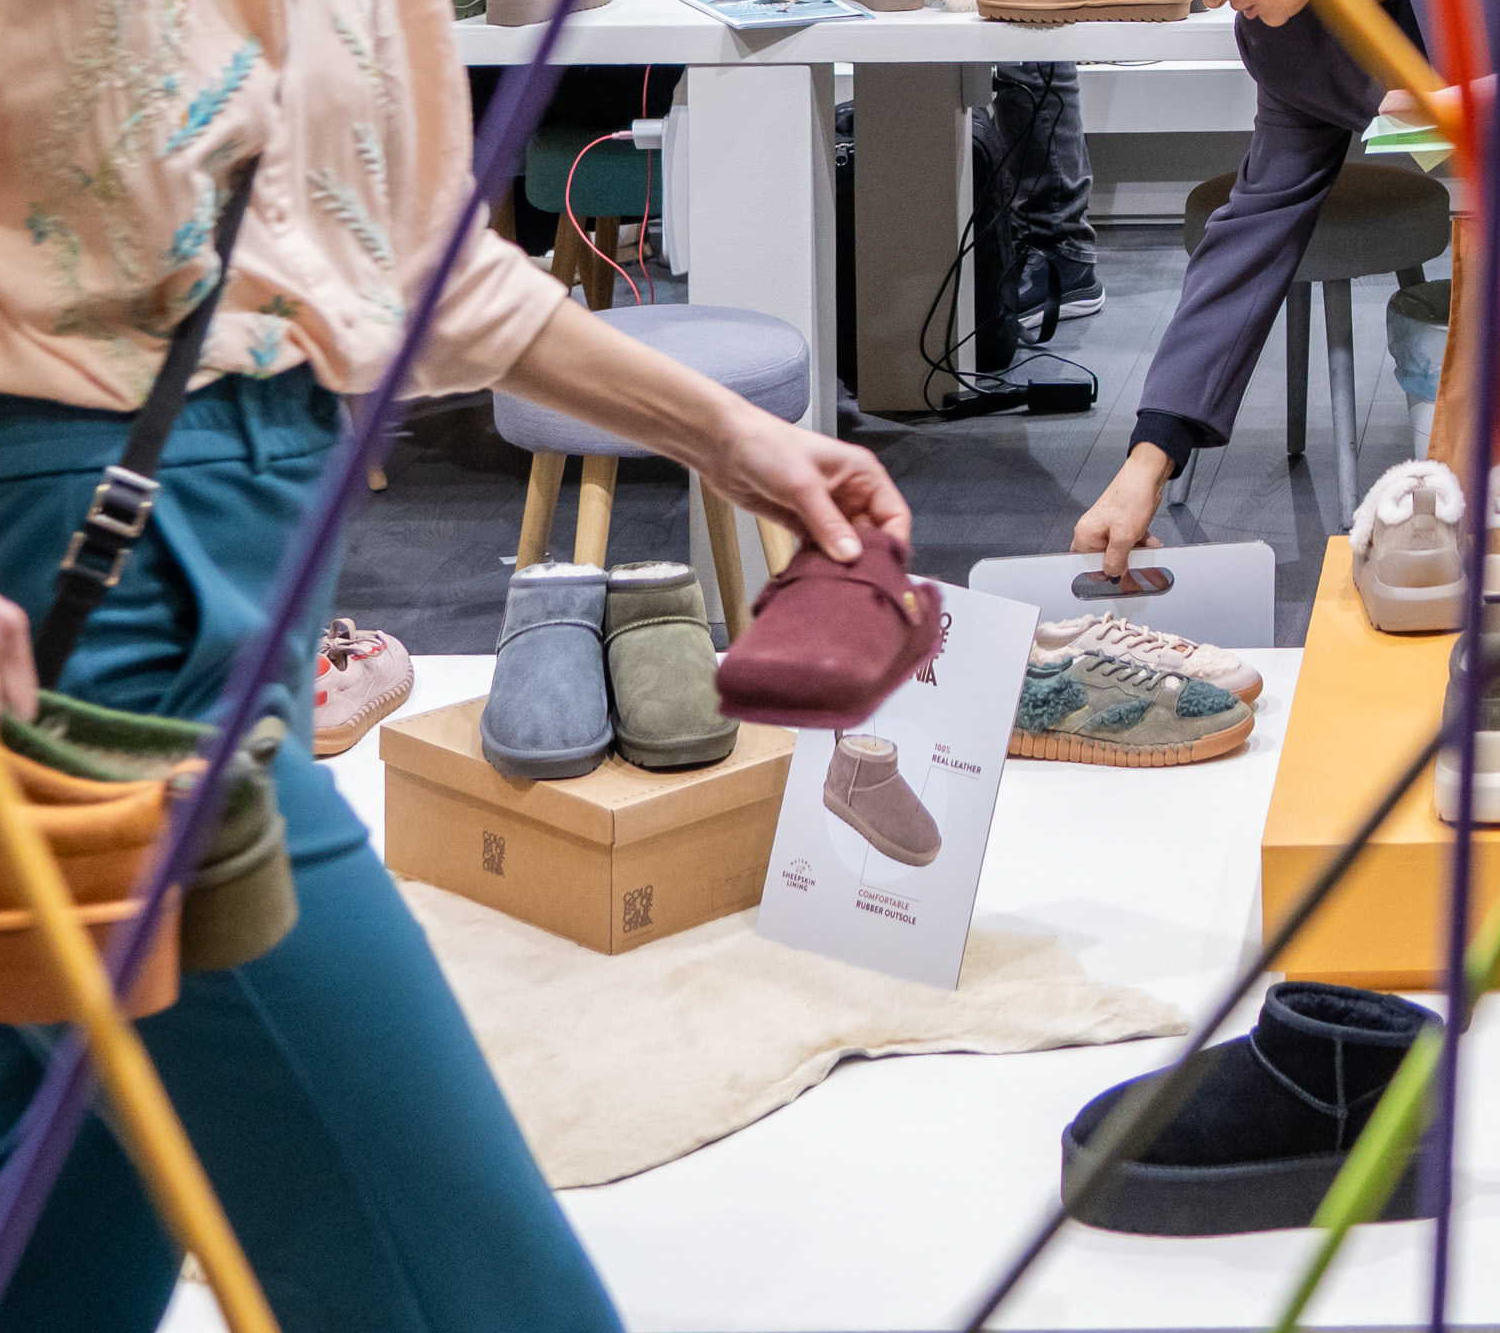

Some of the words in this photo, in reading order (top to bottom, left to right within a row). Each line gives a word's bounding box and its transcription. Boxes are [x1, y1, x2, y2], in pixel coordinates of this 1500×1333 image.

[934, 743, 951, 754] 100%
[931, 754, 950, 766] REAL
[950, 759, 982, 774] LEATHER
[782, 870, 816, 886] SHEEPSKIN
[786, 879, 808, 892] LINING
[858, 888, 910, 911] COMFORTABLE
[855, 899, 884, 915] RUBBER
[884, 909, 917, 926] OUTSOLE
